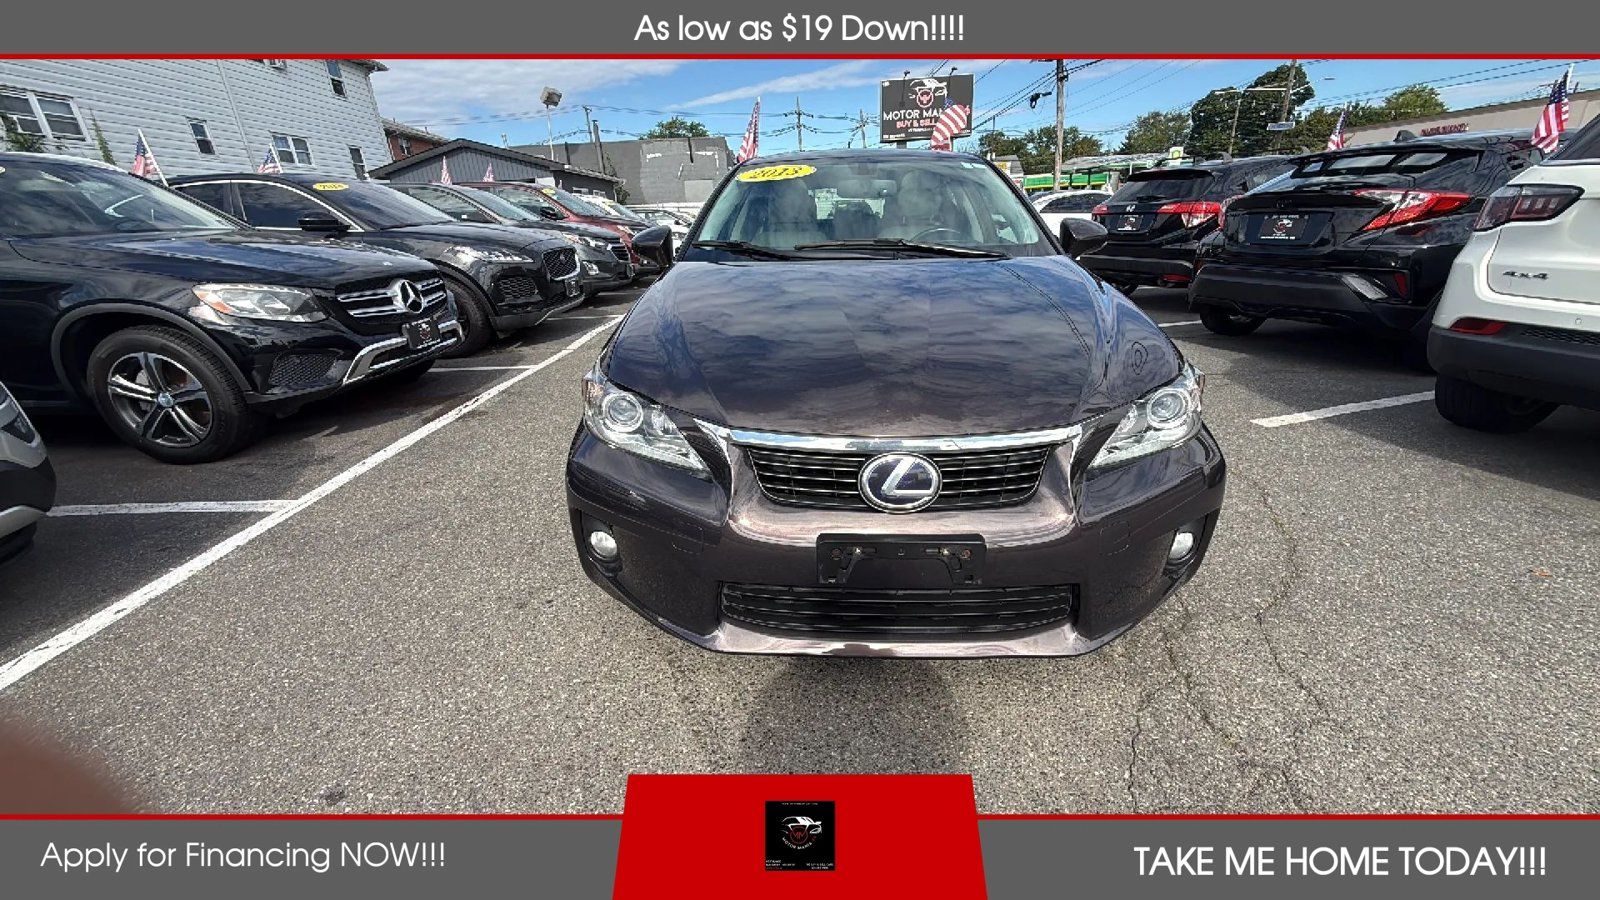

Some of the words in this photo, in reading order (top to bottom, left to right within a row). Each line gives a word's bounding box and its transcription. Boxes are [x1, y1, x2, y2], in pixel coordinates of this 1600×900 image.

[883, 109, 920, 121] MOTOR
[896, 120, 912, 129] BUY
[920, 118, 937, 127] SELL
